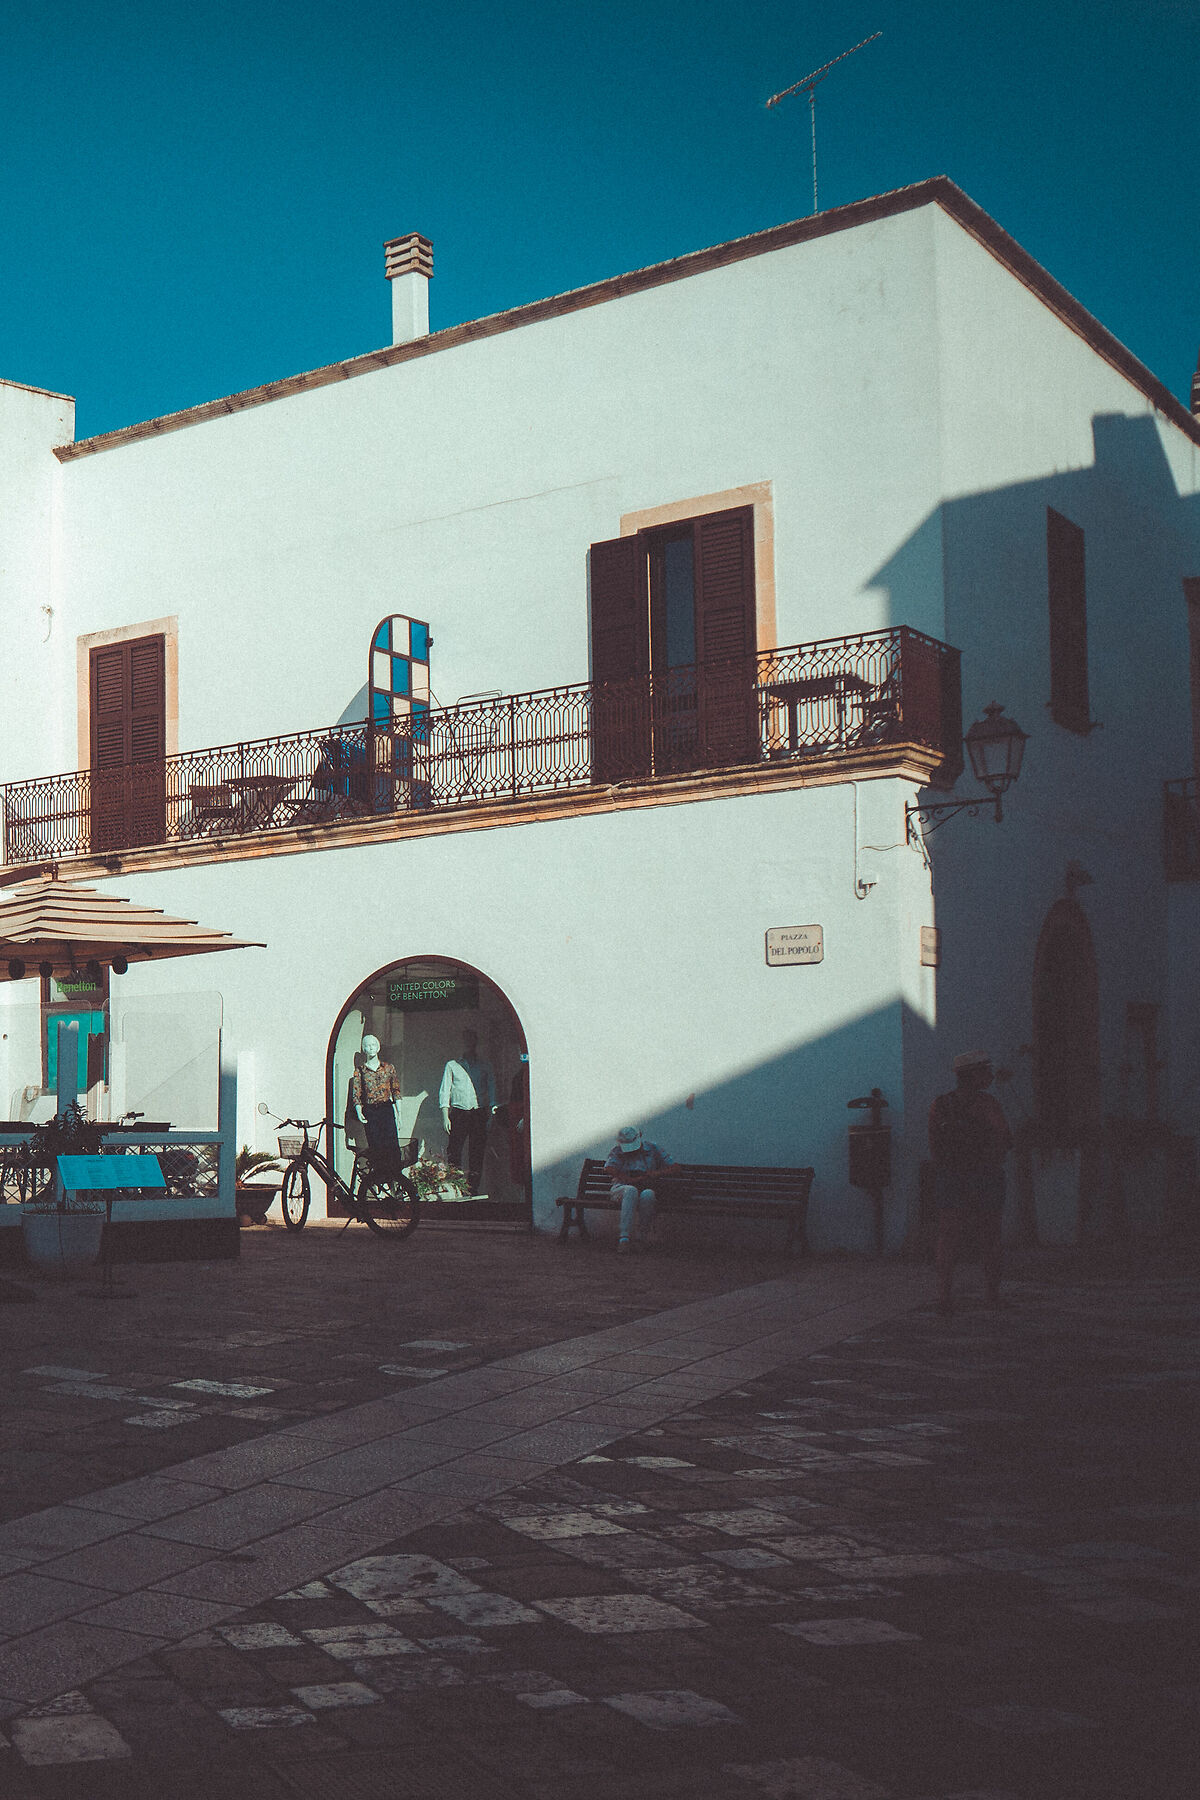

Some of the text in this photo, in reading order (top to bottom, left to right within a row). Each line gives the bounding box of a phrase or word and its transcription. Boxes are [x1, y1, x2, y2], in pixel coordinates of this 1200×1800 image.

[771, 945, 820, 956] DEL POPOLO
[56, 980, 97, 993] Benetton
[390, 980, 456, 992] UNITED COLORS
[390, 993, 401, 1001] OF
